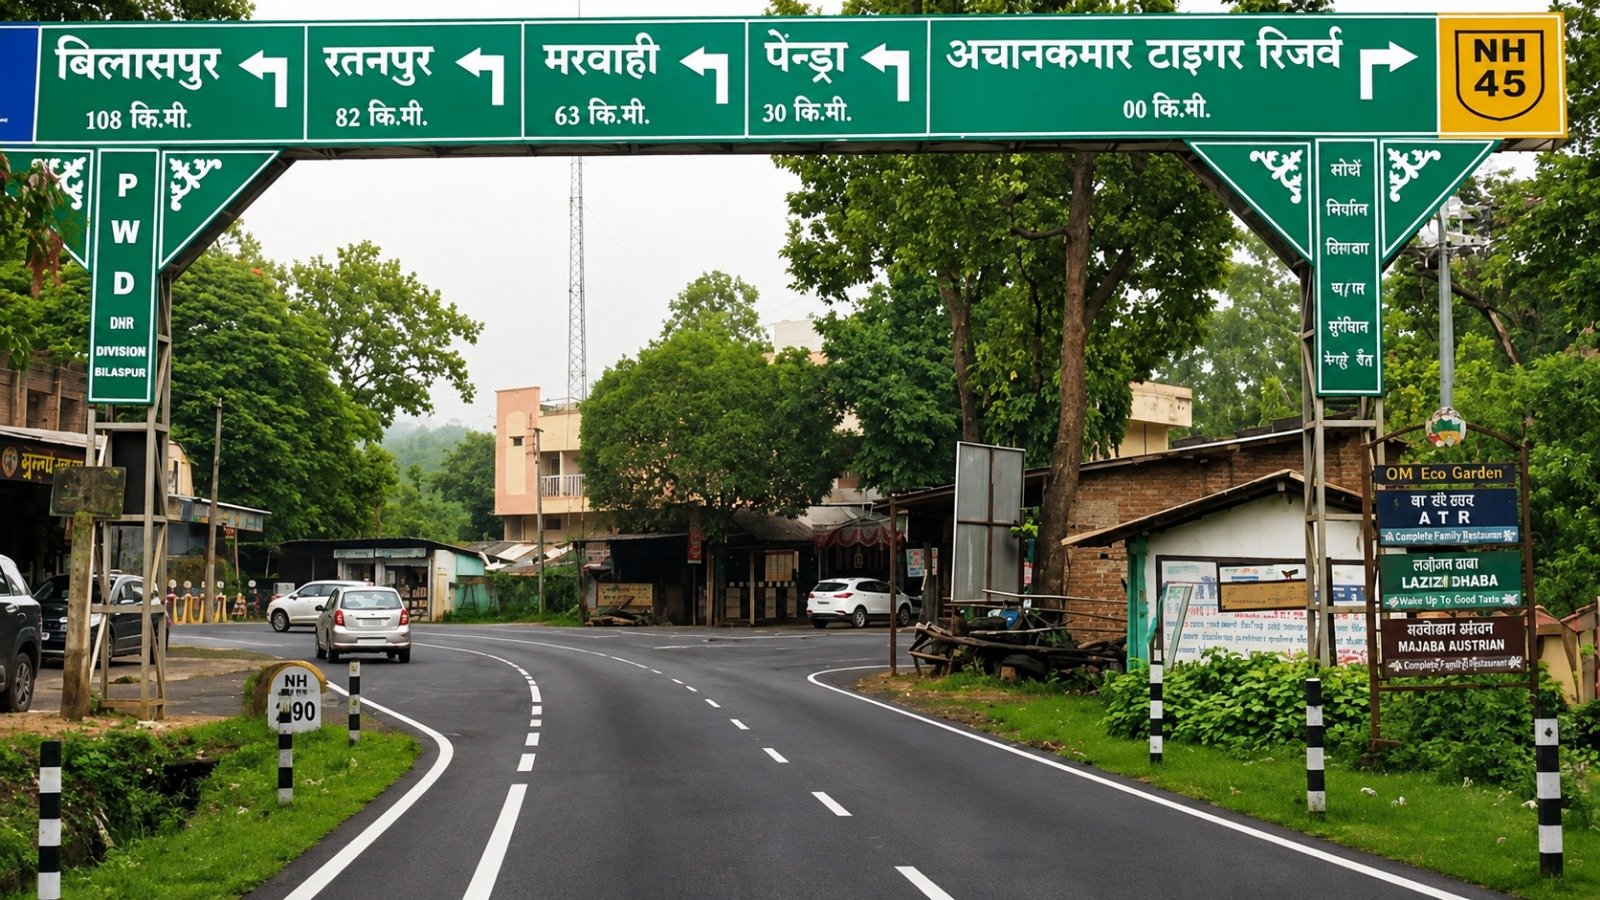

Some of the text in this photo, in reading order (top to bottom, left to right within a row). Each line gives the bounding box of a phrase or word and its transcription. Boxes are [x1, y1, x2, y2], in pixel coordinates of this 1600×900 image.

[55, 35, 222, 90] बिलासपुर
[542, 32, 661, 80] मरवाही
[946, 26, 1344, 76] अचानकमार टाइगर रिजर्व
[1474, 38, 1526, 62] NH
[322, 46, 435, 86] रतनपुर
[1474, 69, 1526, 98] 45
[86, 101, 192, 129] 108 कि.मी.
[335, 99, 428, 127] 82 कि.मी.
[555, 98, 650, 125] 63 कि.मी.
[762, 95, 852, 122] 30 कि.मी.
[1123, 92, 1211, 119] 00 कि.मी.
[96, 346, 146, 357] DIVISION
[94, 367, 146, 377] BILASPUR
[1386, 466, 1503, 480] OM Eco Garden
[1395, 532, 1432, 543] Complete
[1434, 531, 1462, 542] Family
[1452, 574, 1499, 587] DHABA
[1399, 597, 1423, 605] Wake
[1425, 596, 1438, 607] Up
[1440, 595, 1451, 604] To
[1454, 594, 1476, 604] Good
[1398, 639, 1505, 653] MAJABA AUSTRIAN
[284, 674, 307, 688] NH
[276, 701, 316, 722] 90
